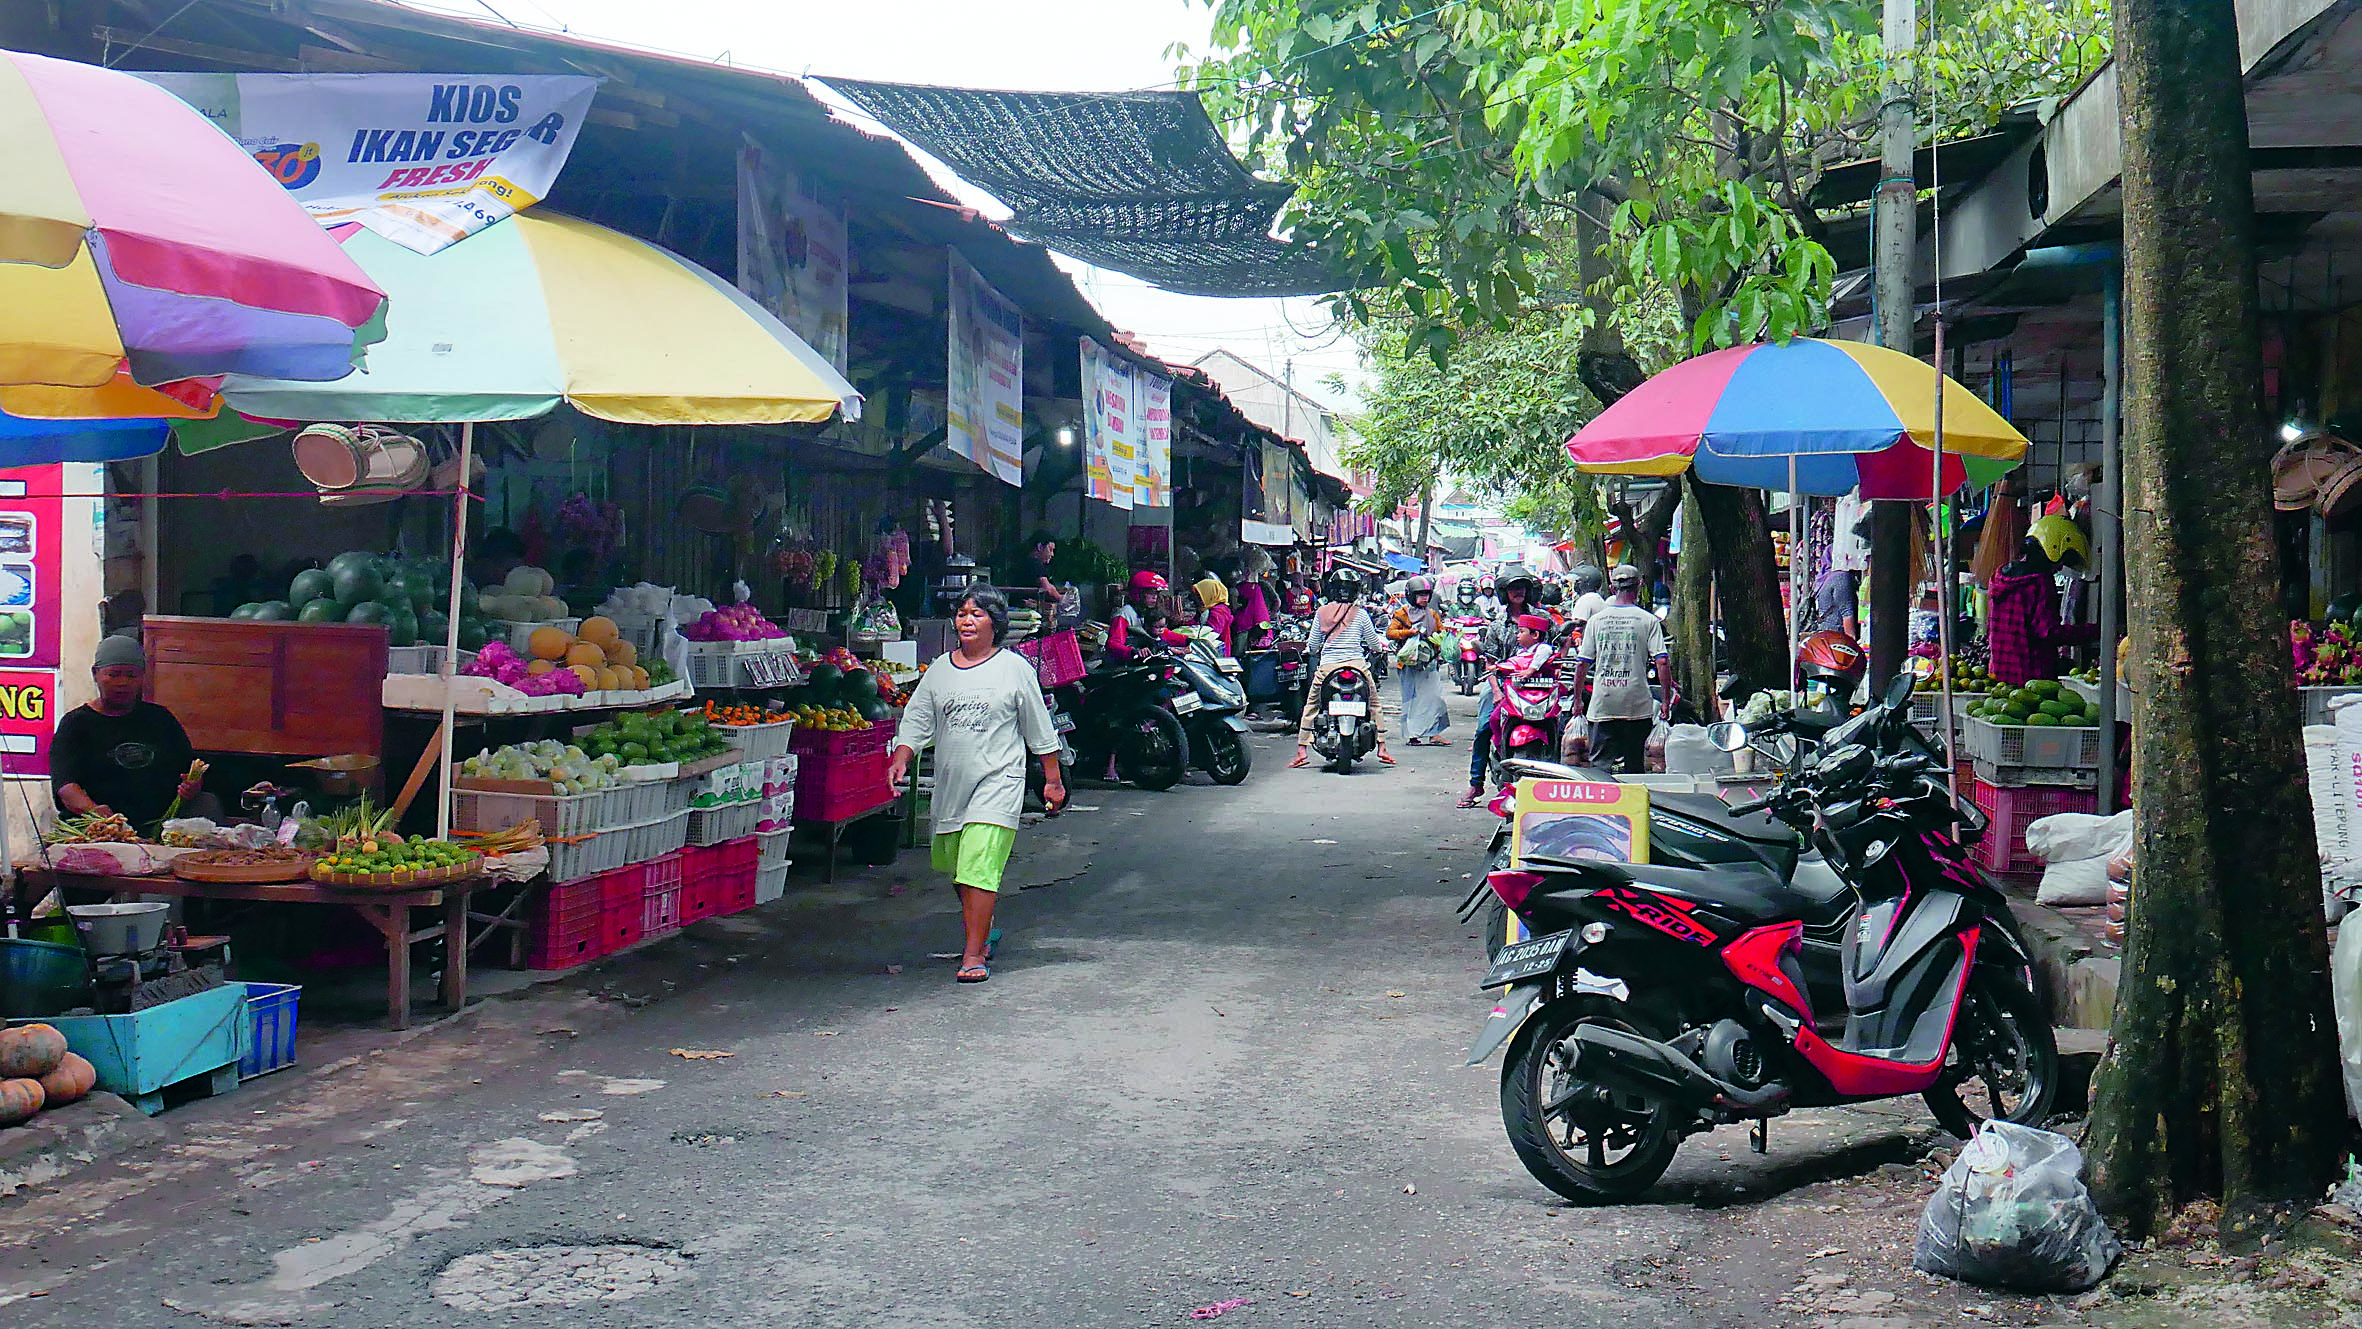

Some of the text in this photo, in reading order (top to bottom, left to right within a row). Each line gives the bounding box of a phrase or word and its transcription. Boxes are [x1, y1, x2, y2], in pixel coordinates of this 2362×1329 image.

[426, 84, 522, 124] KIOS
[347, 129, 445, 163] IKAN
[376, 157, 497, 190] FRESH
[1548, 784, 1595, 800] JUAL
[1511, 943, 1543, 963] 2035
